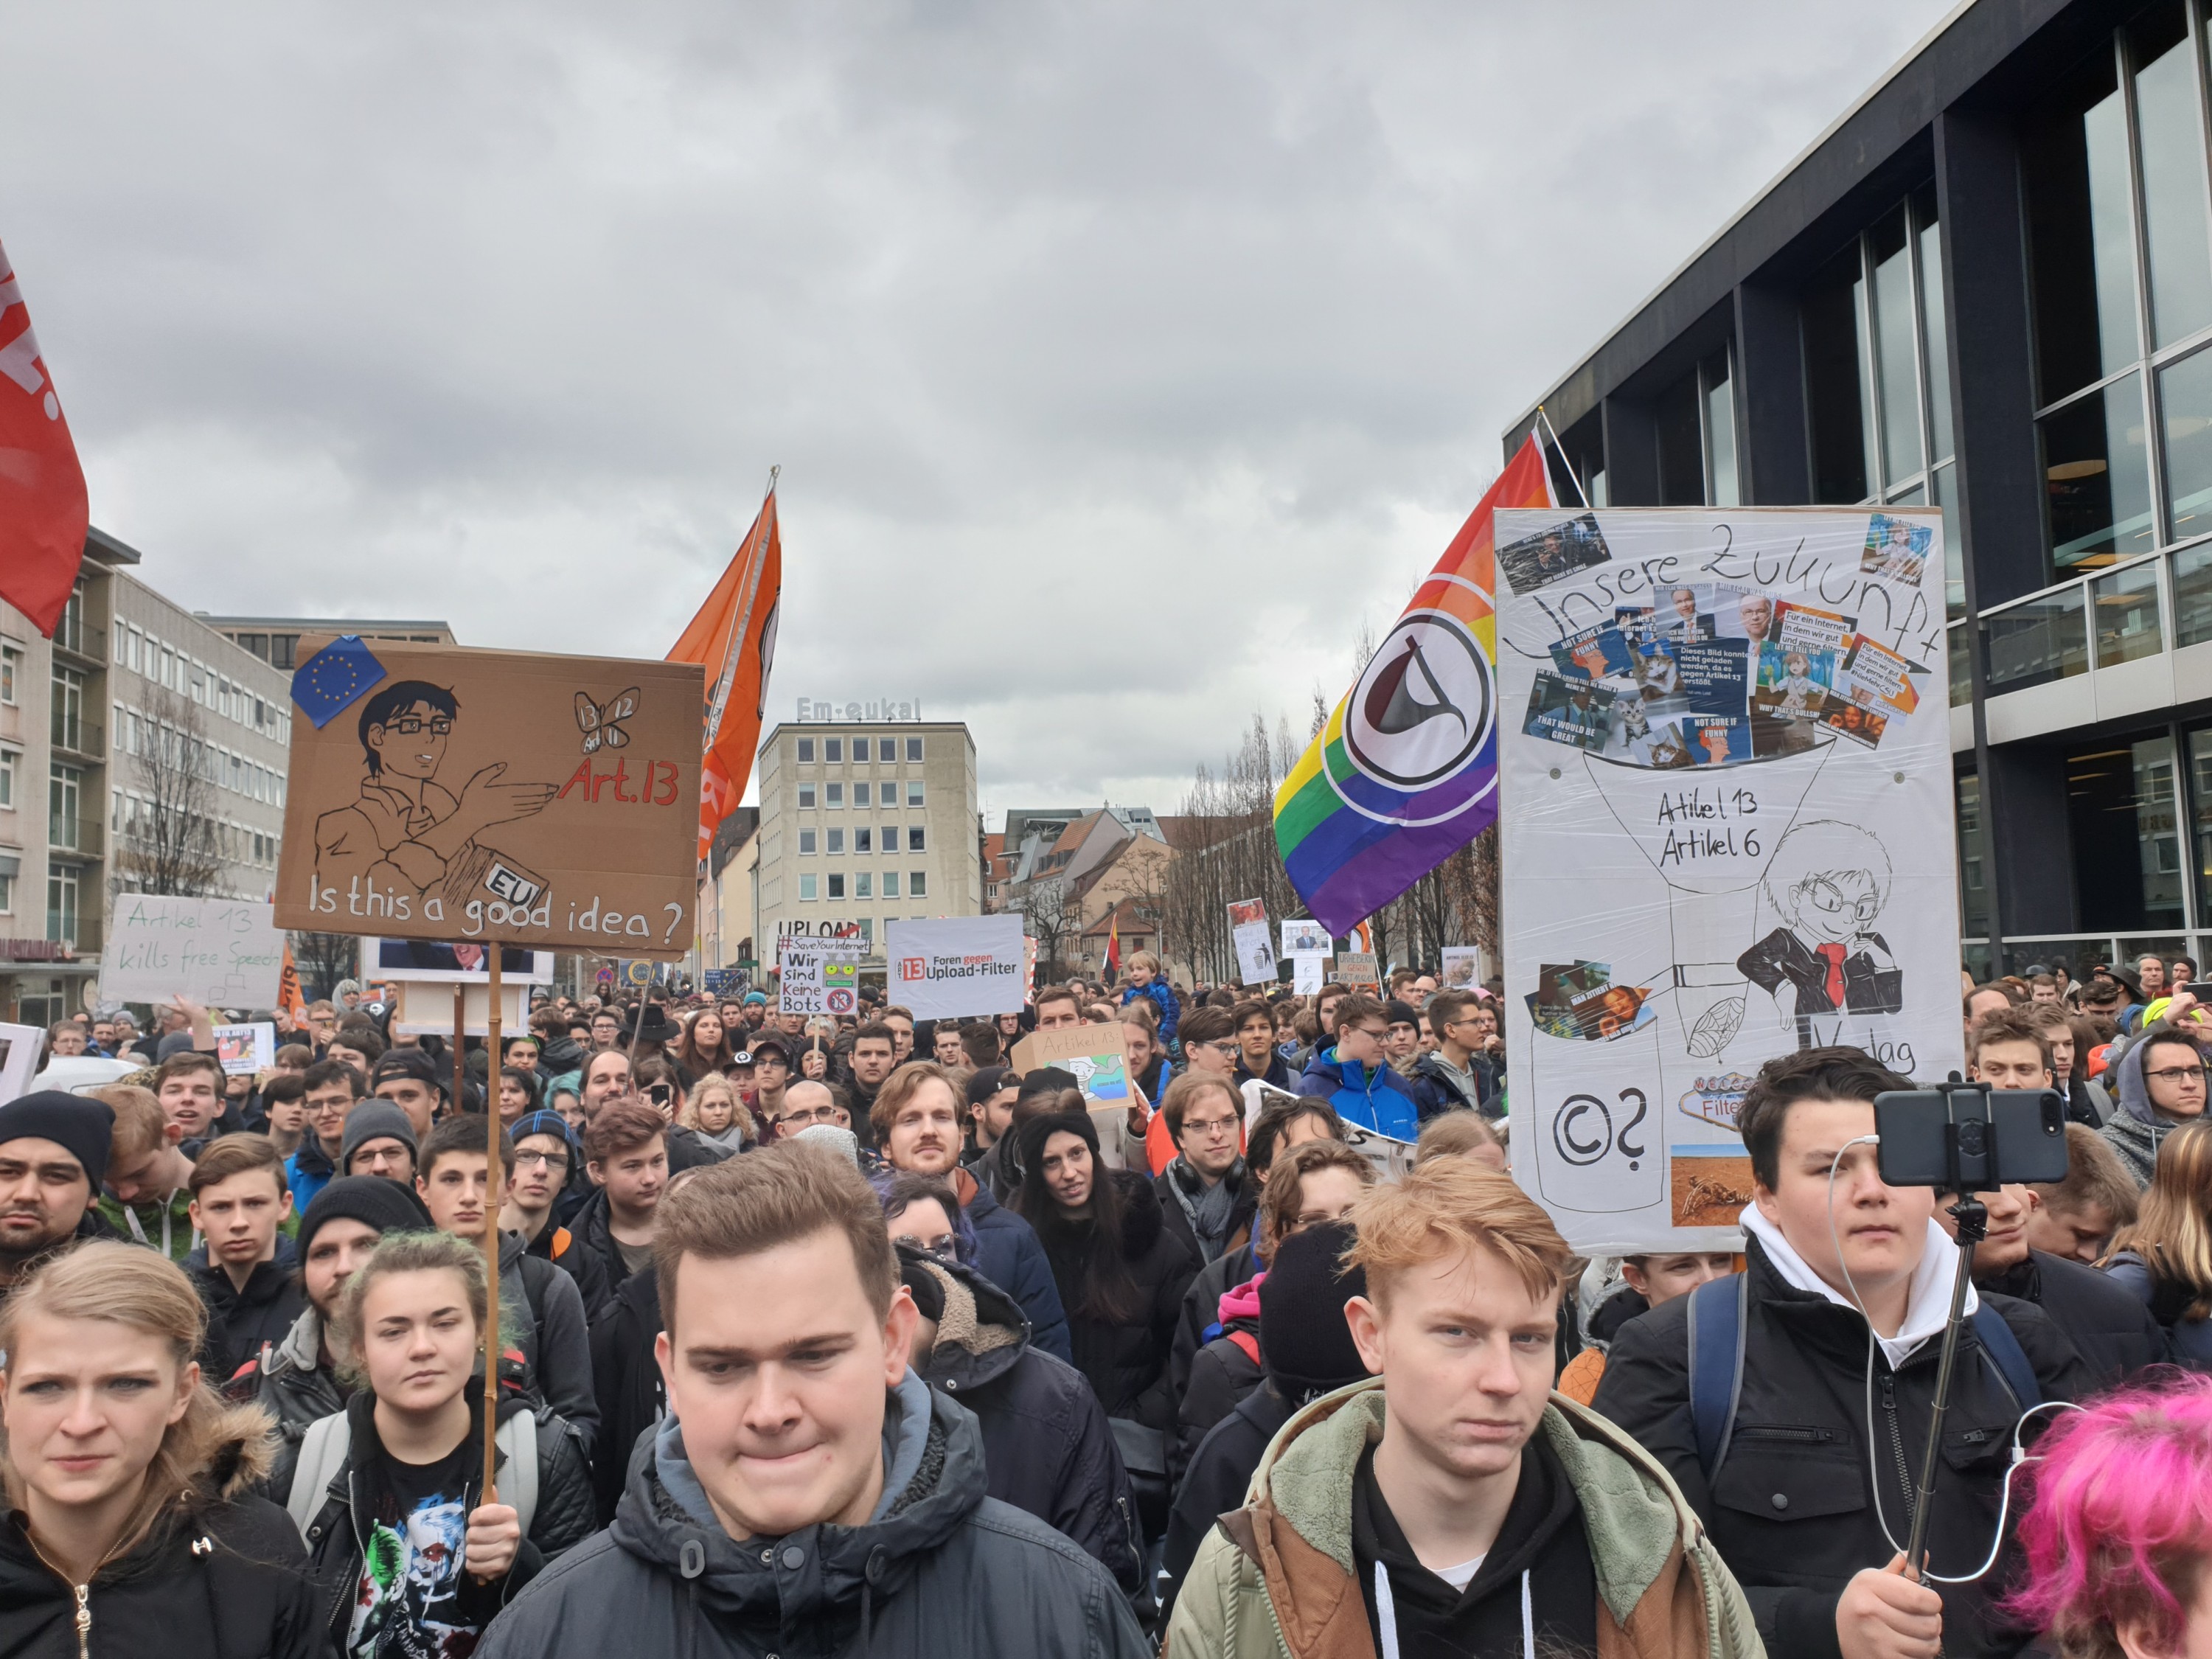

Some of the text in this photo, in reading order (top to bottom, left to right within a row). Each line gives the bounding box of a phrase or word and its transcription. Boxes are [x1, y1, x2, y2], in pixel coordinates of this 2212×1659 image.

[1700, 524, 1939, 662] Zukunft
[1786, 611, 1798, 621] Für
[1801, 616, 1813, 625] ein
[1561, 625, 1605, 650] NOT SURE IF
[1782, 636, 1798, 644] und
[1784, 623, 1792, 631] in
[1793, 625, 1810, 636] dem
[1812, 630, 1825, 639] wir
[1574, 640, 1599, 657] FUNNY
[1862, 644, 1874, 654] Für
[1874, 649, 1884, 658] ein
[1702, 656, 1733, 664] geladen
[1865, 656, 1879, 667] dem
[1879, 664, 1889, 672] wir
[1888, 668, 1899, 678] gut
[1705, 672, 1731, 680] Artikel
[1854, 661, 1866, 671] und
[1865, 667, 1884, 680] gerne
[580, 705, 597, 728] 13
[615, 698, 633, 719] 12
[1759, 703, 1794, 714] WHY THAT'S
[1537, 714, 1596, 737] THAT WOULD BE
[1694, 717, 1737, 727] NOT SURE IF
[1551, 730, 1576, 743] GREAT
[1705, 729, 1728, 737] FUNNY
[1658, 787, 1758, 826] Artikel 13
[1660, 827, 1761, 868] Artikel 6
[490, 868, 539, 907] EU
[309, 874, 336, 914] Is
[348, 877, 411, 922] this
[423, 897, 445, 922] a
[461, 891, 552, 937] good
[568, 896, 651, 938] idea
[128, 900, 253, 933] Artikel 13
[119, 941, 169, 971] kills
[181, 940, 219, 973] free
[787, 953, 819, 967] Wir
[933, 955, 993, 966] Foren gegen
[784, 968, 815, 981] sind
[904, 959, 925, 979] 13
[926, 961, 1017, 981] Upload-Filter
[782, 982, 821, 997] Keine
[782, 996, 821, 1012] Bots
[1043, 1032, 1119, 1055] Artikel 13:
[1814, 1020, 1916, 1076] Vlag
